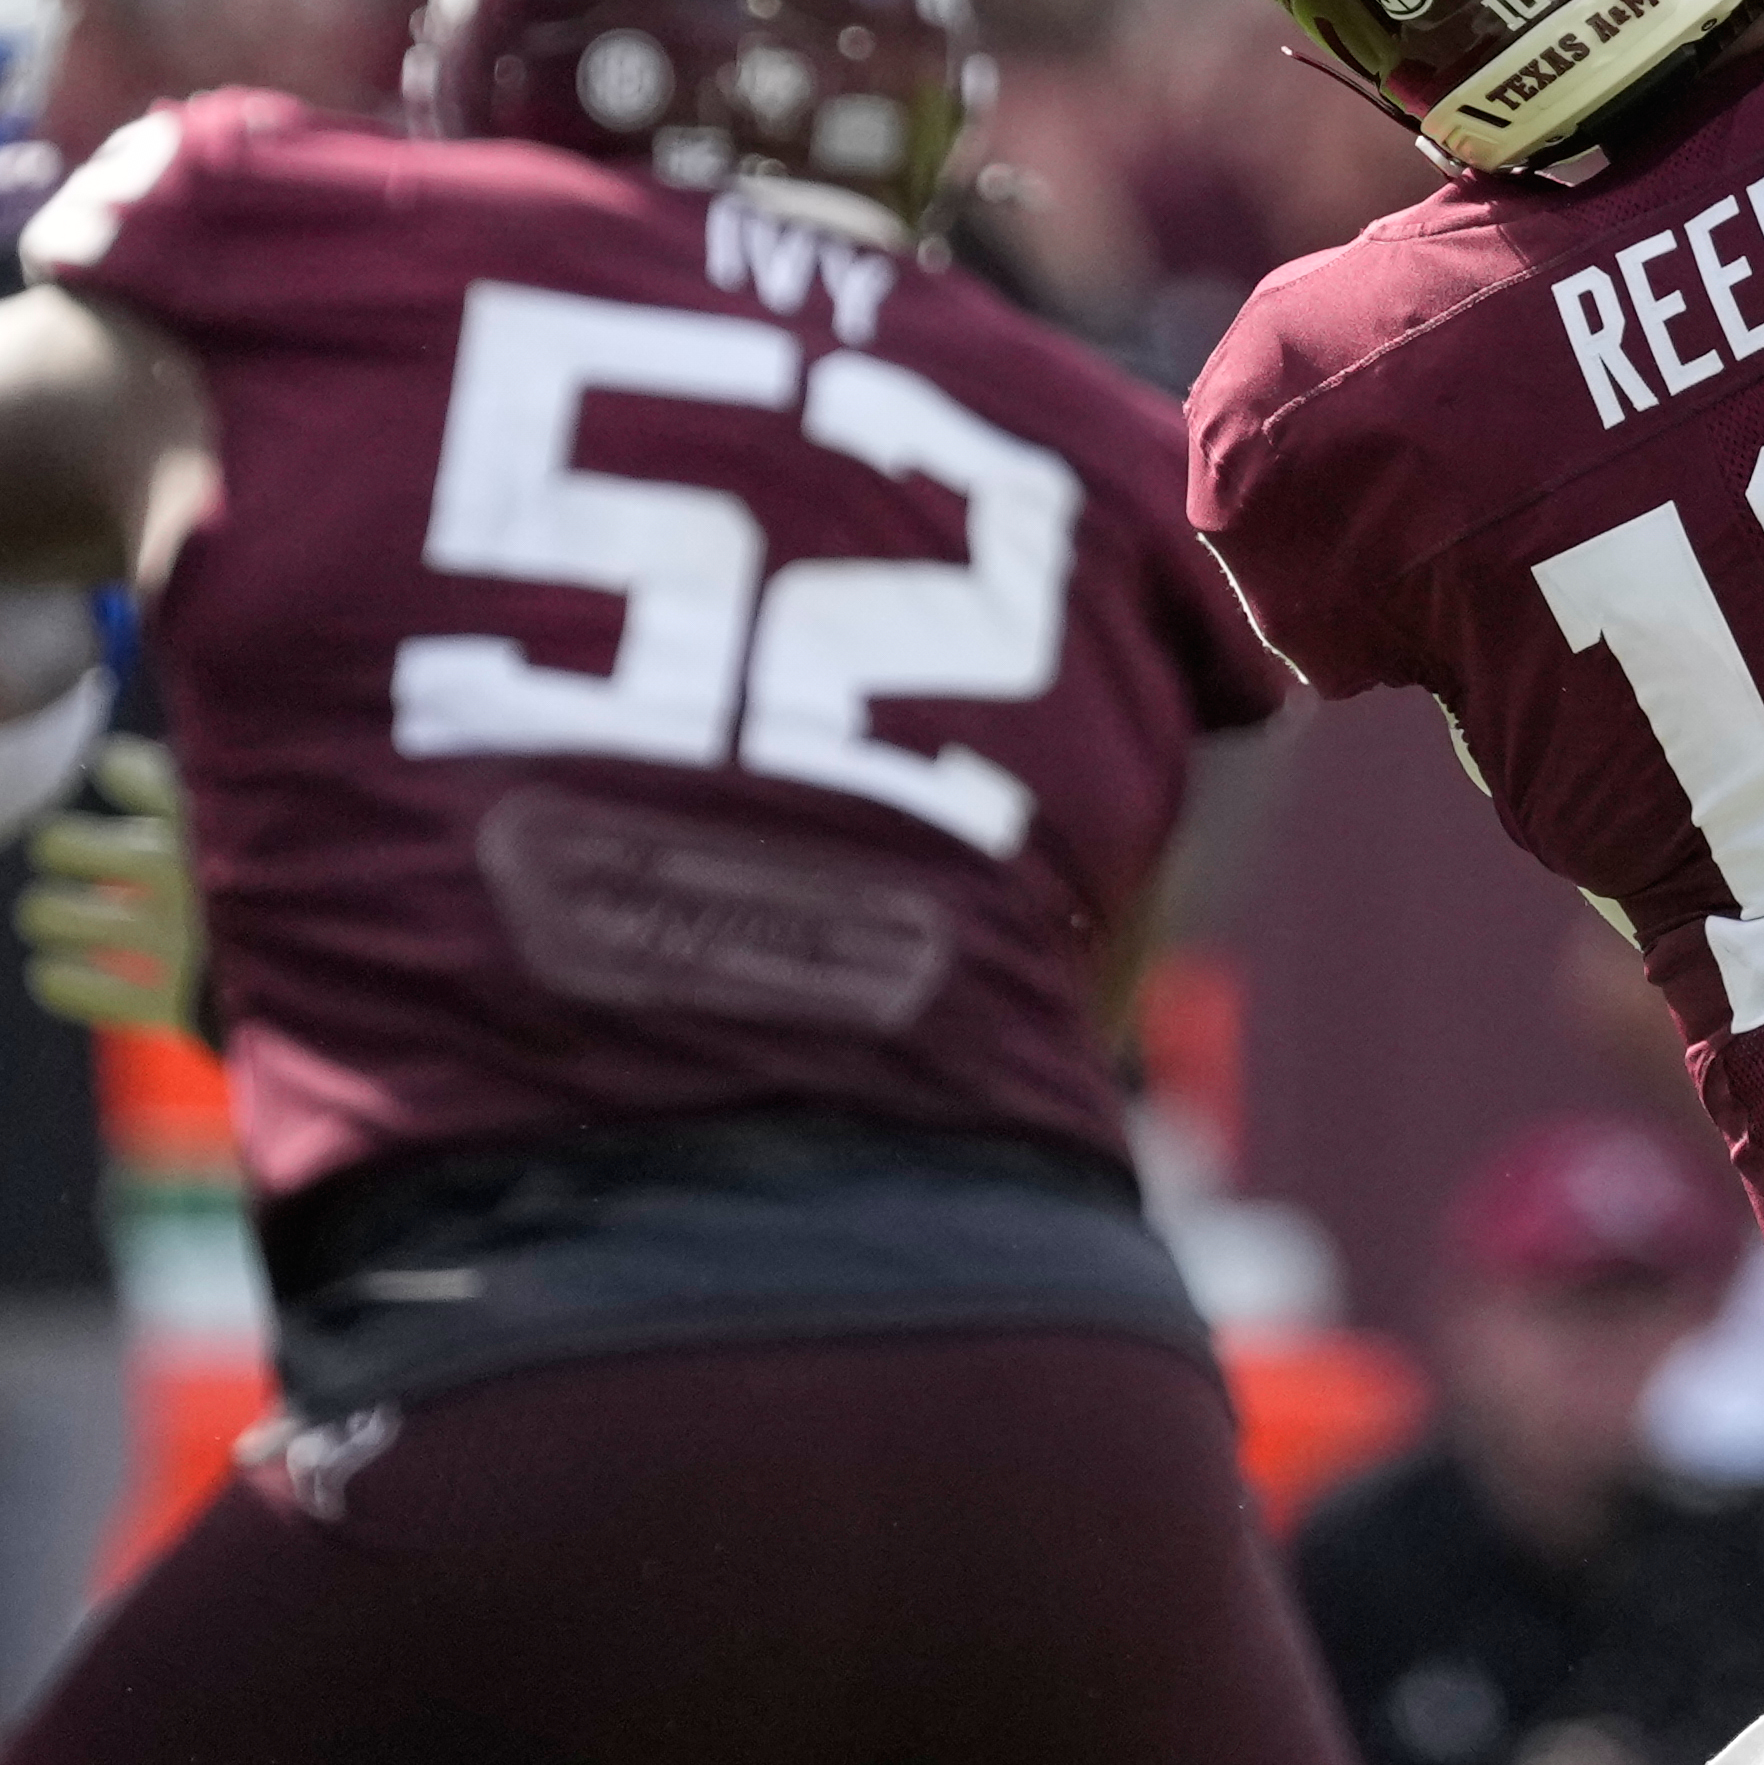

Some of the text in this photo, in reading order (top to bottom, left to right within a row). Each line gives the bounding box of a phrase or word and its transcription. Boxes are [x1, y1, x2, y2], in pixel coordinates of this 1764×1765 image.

[1484, 32, 1591, 112] TEXAS
[704, 192, 899, 348] IVY
[389, 276, 1085, 863] 52
